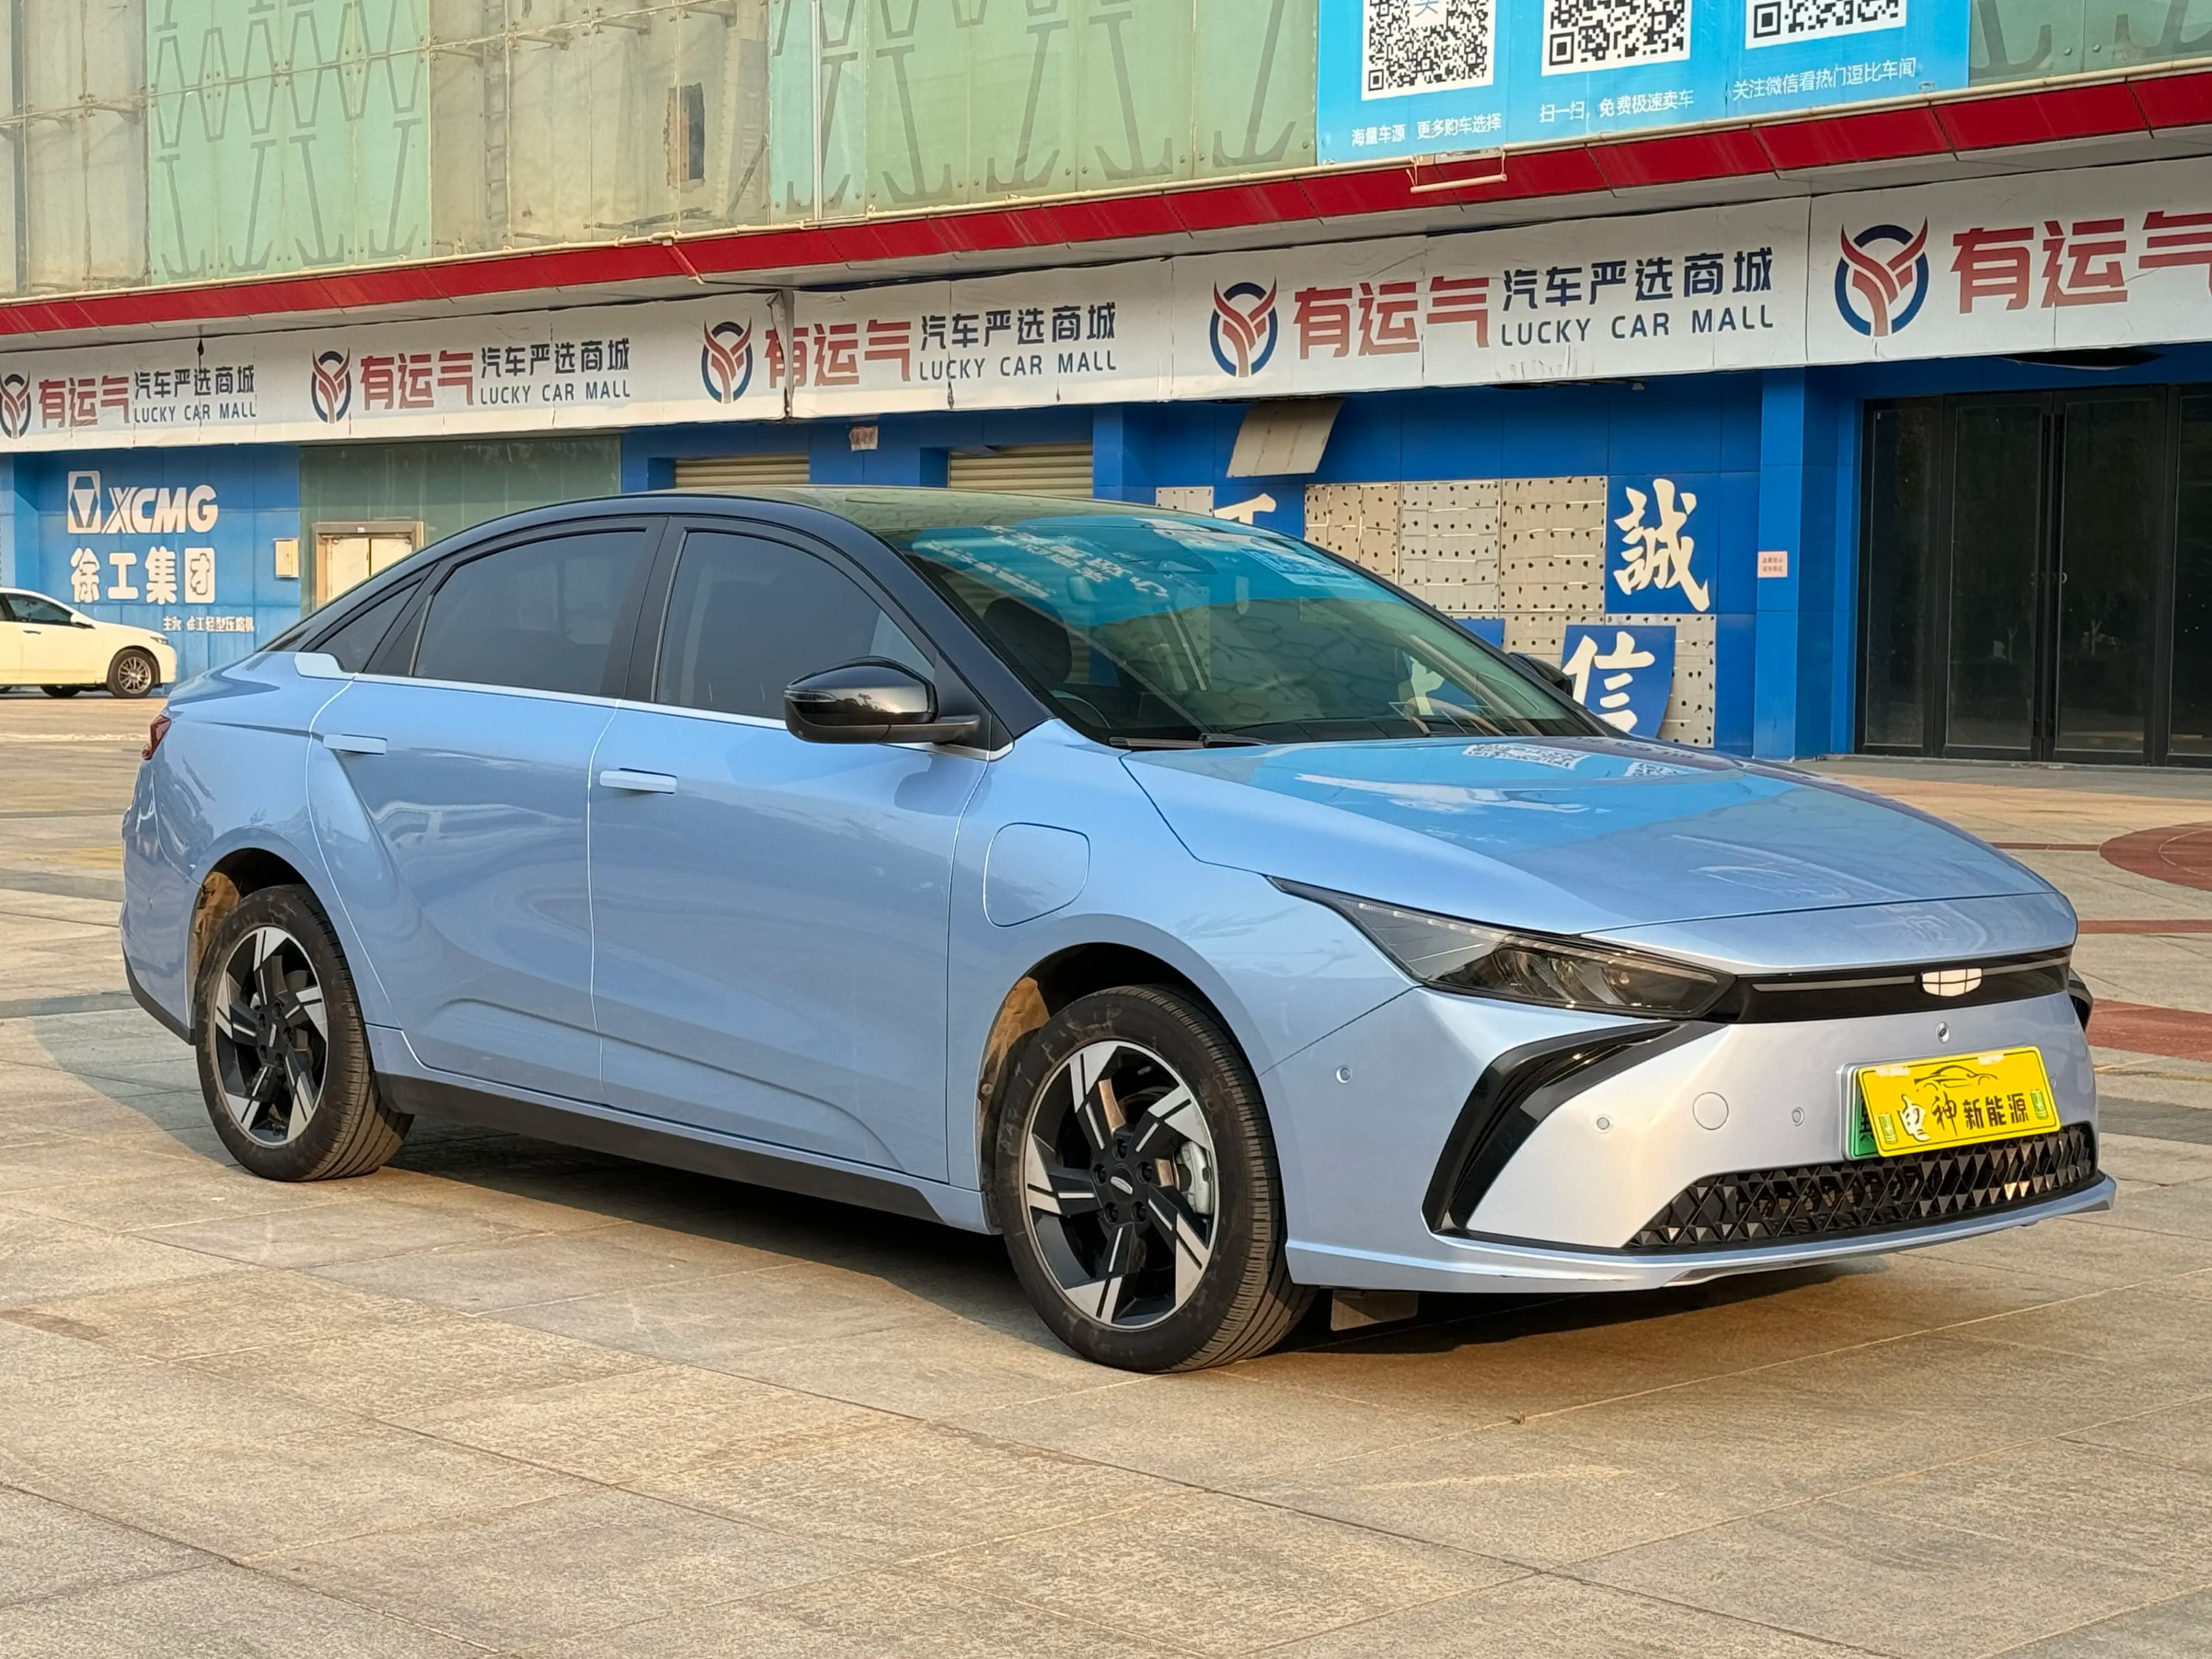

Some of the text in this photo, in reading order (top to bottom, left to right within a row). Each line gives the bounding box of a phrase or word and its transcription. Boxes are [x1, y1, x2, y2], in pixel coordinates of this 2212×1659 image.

[1351, 113, 1502, 147] 海量车源 更多购车选择
[1502, 247, 1774, 311] 汽车严选商城
[1950, 211, 2212, 314] 有运气
[920, 302, 1116, 351] 汽车严选商城
[1292, 275, 1490, 360] 有运气
[1501, 304, 1774, 346] LUCKY CAR MALL
[480, 338, 630, 379] 汽车严选商城
[763, 319, 911, 389] 有运气
[919, 350, 1117, 381] LUCKY CAR MALL
[39, 376, 130, 429] 有运气
[134, 365, 255, 400] 汽车严选商城
[359, 350, 474, 411] 有运气
[480, 379, 631, 405] LUCKY CAR MALL
[134, 402, 256, 423] LUCKY CAR MALL
[101, 484, 218, 533] XCMG
[71, 546, 215, 605] 徐工集团
